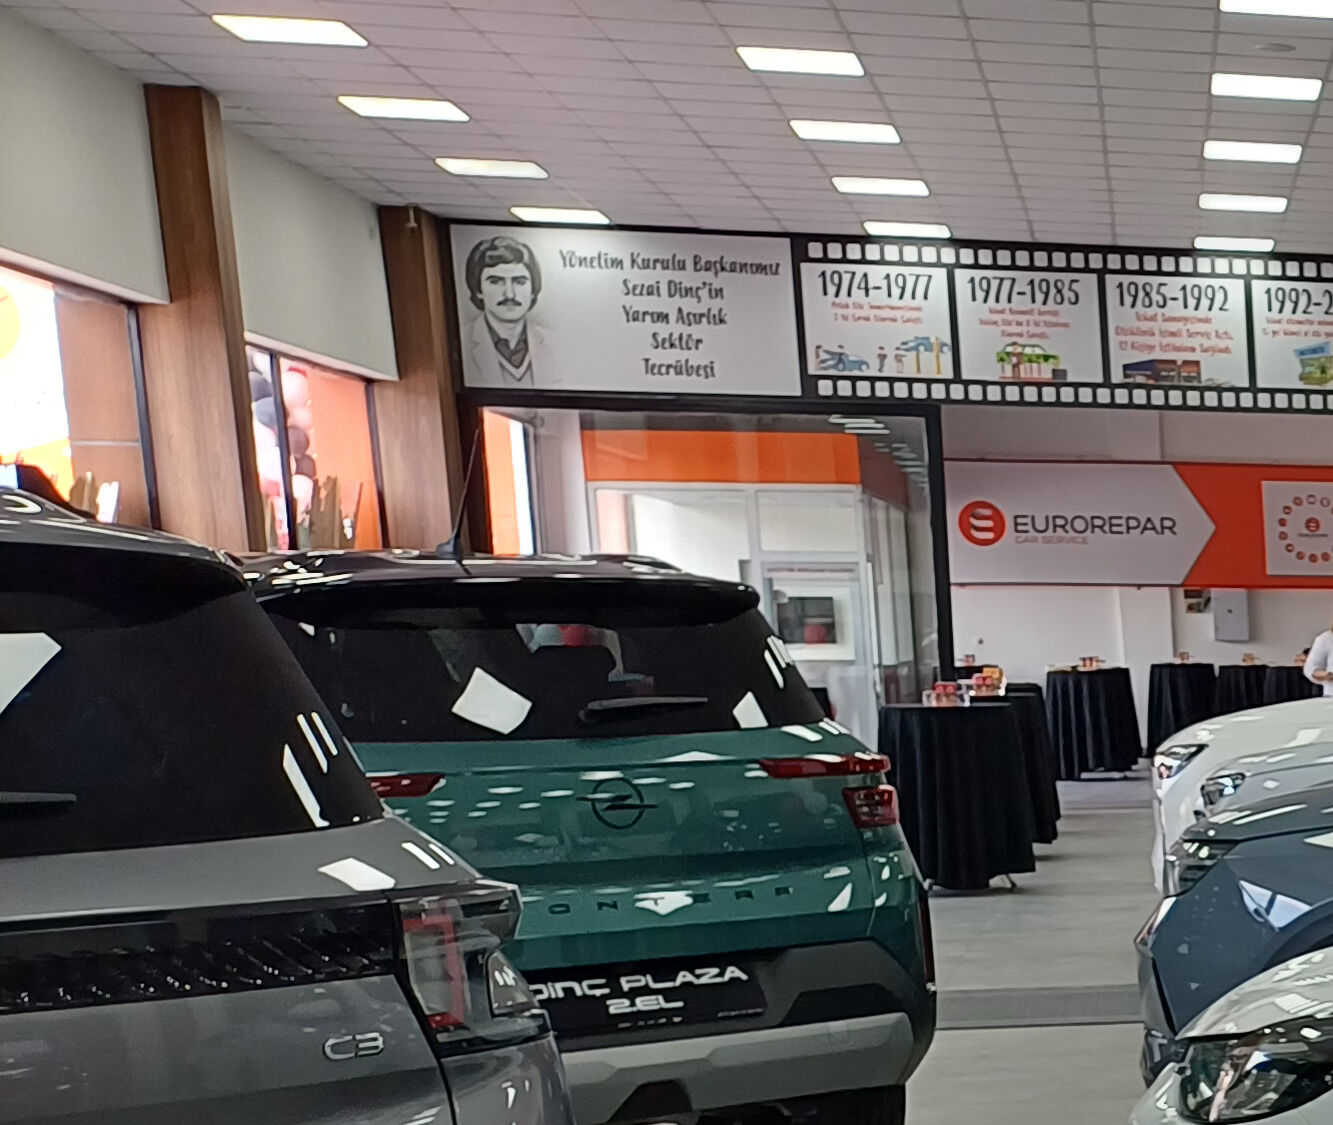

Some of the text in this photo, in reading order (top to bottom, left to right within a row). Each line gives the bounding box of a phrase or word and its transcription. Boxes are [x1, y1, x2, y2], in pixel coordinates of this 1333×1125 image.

[559, 249, 781, 278] Yönetim Kurulu Başkanımız
[622, 278, 724, 303] Sezai Dinç'in
[818, 270, 932, 301] 1974-1977
[967, 276, 1080, 306] 1977-1985
[1116, 281, 1230, 312] 1985-1992
[622, 304, 670, 325] Yarım
[651, 332, 703, 351] Sektör
[642, 358, 716, 379] Tecrübesi
[1013, 514, 1177, 536] EUROREPAR
[1014, 535, 1089, 545] CAR SERVICE
[619, 965, 749, 992] PLAZA
[323, 1031, 385, 1061] C3
